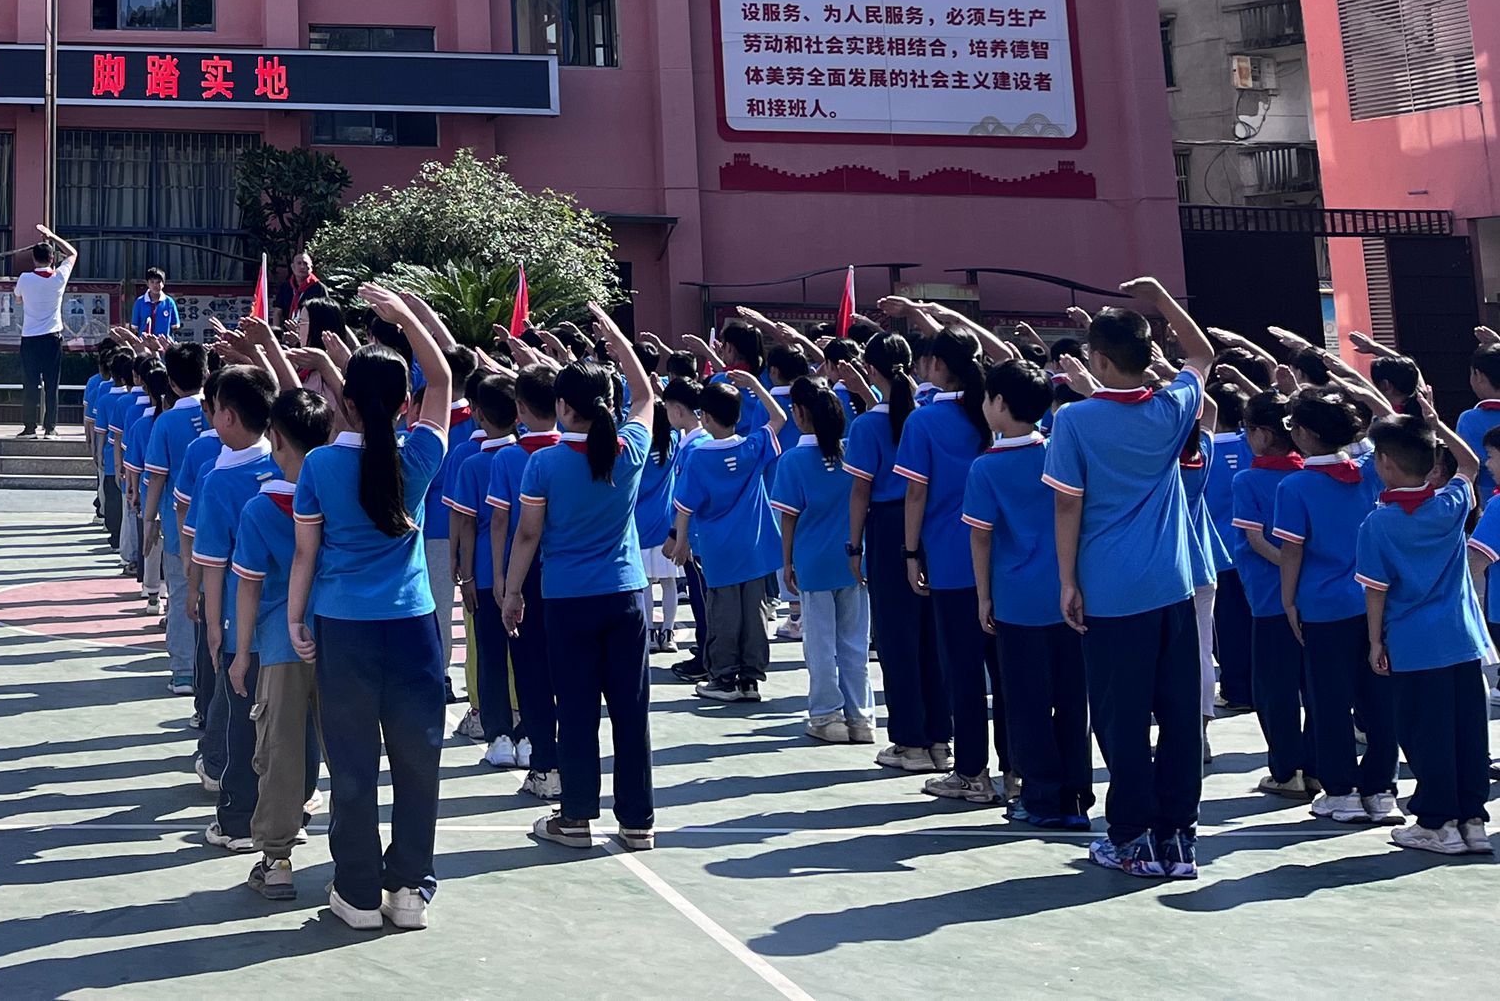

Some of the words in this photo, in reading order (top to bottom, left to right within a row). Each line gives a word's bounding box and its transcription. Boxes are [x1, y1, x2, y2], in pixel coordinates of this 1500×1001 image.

[741, 2, 1047, 28] 设服务、为人民服务，必须与生产
[743, 33, 1050, 60] 劳动和社会实践相结合，培养德智
[92, 54, 289, 100] 脚踏实地
[744, 65, 1053, 92] 体美劳全面发展的社会主义建设者
[746, 97, 838, 119] 和接班人。
